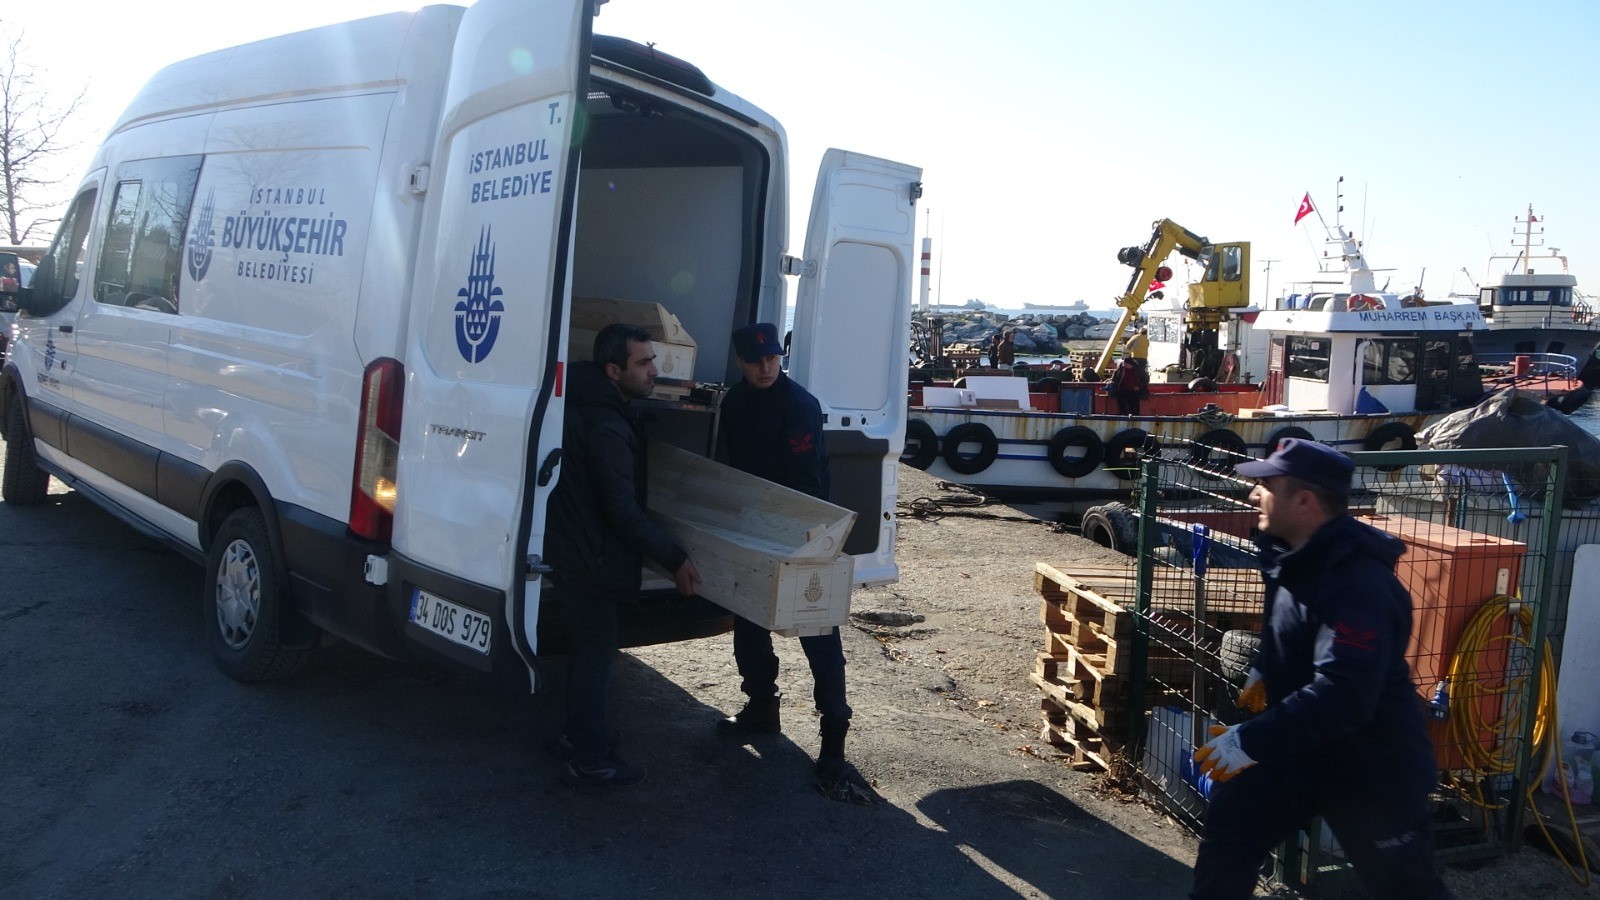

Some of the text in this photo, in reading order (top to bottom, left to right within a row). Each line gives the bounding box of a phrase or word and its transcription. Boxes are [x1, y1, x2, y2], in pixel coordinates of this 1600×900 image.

[548, 102, 562, 125] T.
[221, 210, 348, 263] BÜYÜKŞEHİR
[237, 260, 314, 285] BELEDİYESİ
[1359, 311, 1481, 323] MUHARREM BAŞKAN
[430, 424, 487, 442] TRANSIT
[416, 595, 429, 623] 34
[432, 602, 457, 634] DOS
[461, 613, 490, 647] 979
